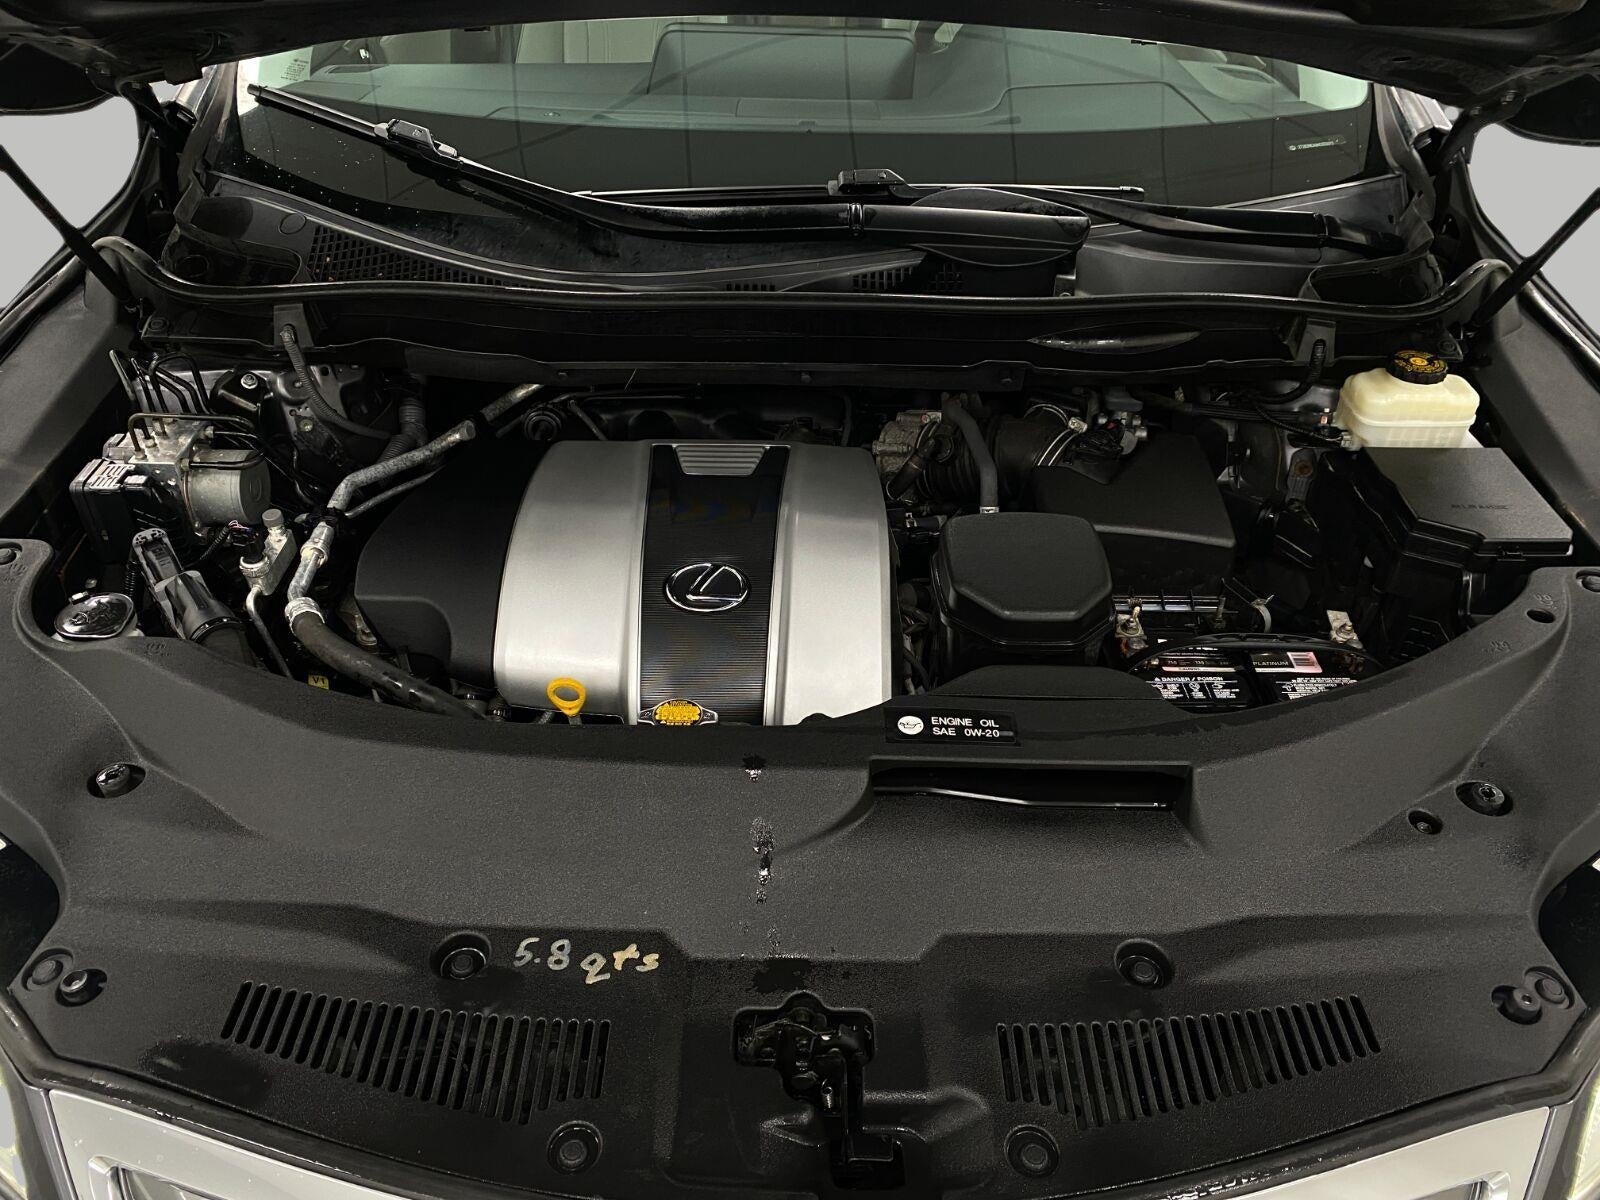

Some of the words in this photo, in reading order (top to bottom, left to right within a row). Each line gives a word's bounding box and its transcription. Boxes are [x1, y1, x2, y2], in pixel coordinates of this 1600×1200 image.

[931, 716, 973, 726] ENGINE
[980, 718, 1000, 728] OIL
[932, 727, 957, 736] SAE
[964, 728, 1000, 737] 0W-20
[513, 937, 571, 971] 5.8
[580, 943, 660, 985] qts
